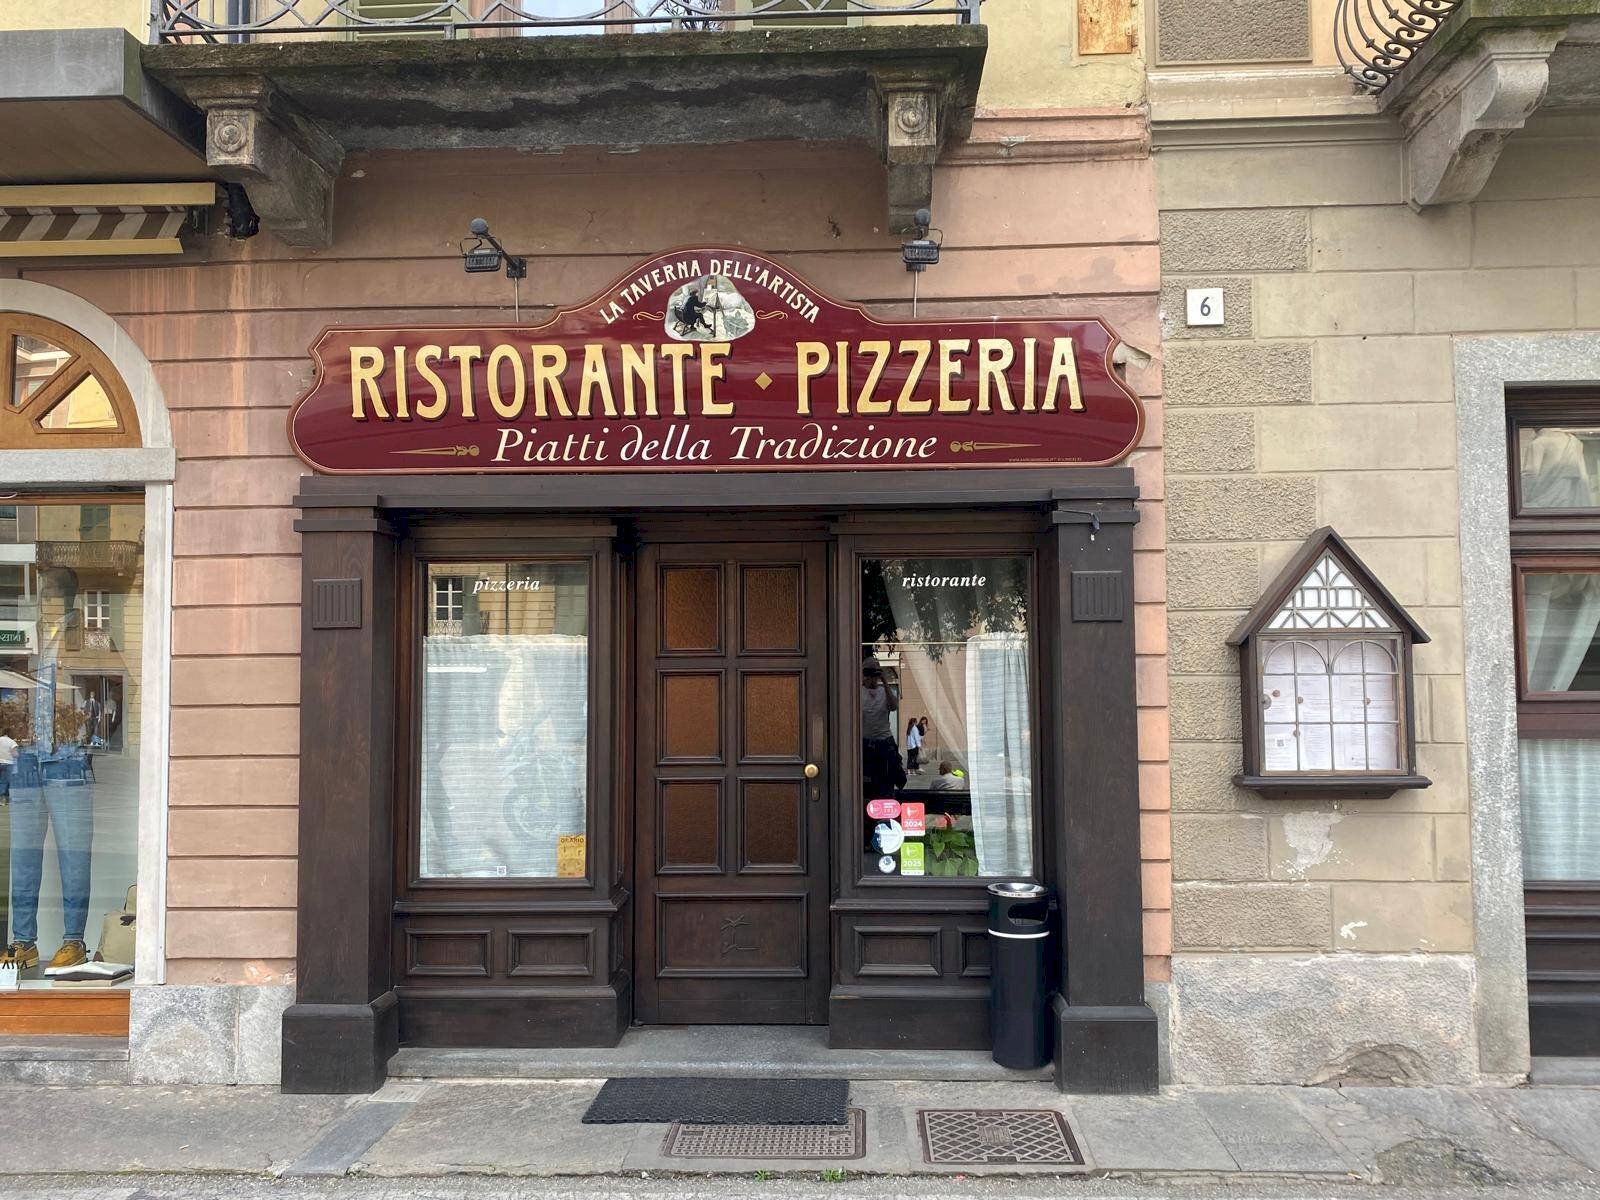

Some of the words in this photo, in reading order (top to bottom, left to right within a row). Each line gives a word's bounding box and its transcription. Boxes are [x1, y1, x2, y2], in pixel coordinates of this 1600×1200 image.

[599, 300, 625, 325] LA
[620, 259, 702, 306] TAVERNA
[710, 259, 821, 324] DELL'ARTISTA
[1200, 296, 1211, 317] 6
[349, 342, 736, 420] RISTORANTE
[796, 336, 1086, 415] PIZZERIA
[491, 427, 610, 462] Piatti
[620, 424, 712, 462] della
[729, 423, 938, 460] Tradizione
[472, 576, 540, 595] pizzeria
[902, 573, 987, 587] ristorante
[904, 820, 923, 828] 2024
